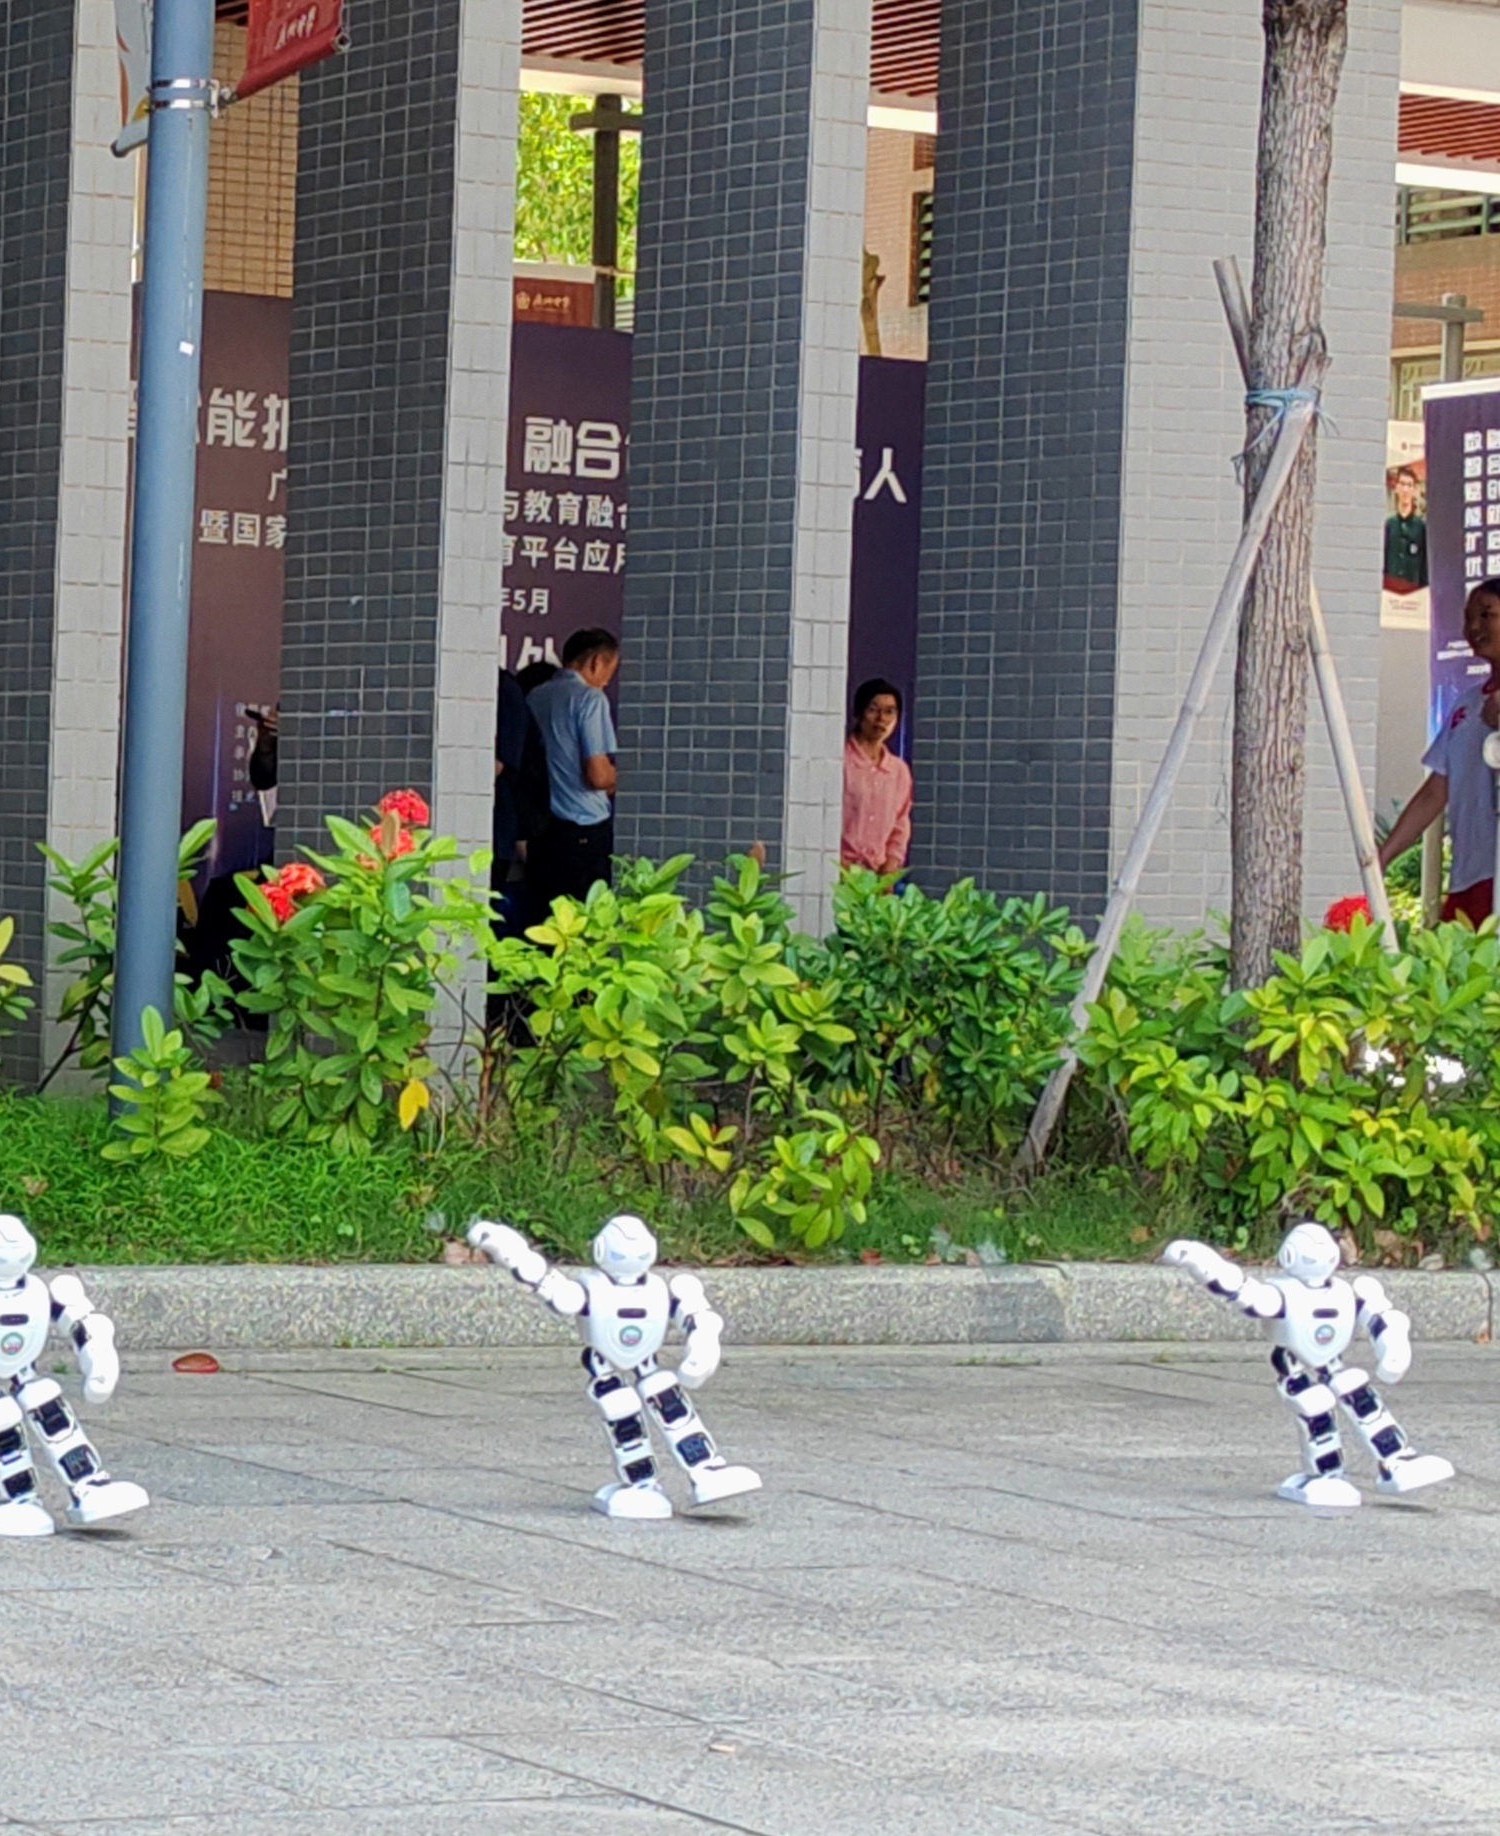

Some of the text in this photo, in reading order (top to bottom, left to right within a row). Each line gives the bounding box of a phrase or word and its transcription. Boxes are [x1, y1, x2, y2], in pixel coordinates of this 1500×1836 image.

[523, 416, 630, 479] 融合
[856, 446, 908, 504] 人
[198, 508, 288, 549] 暨国家
